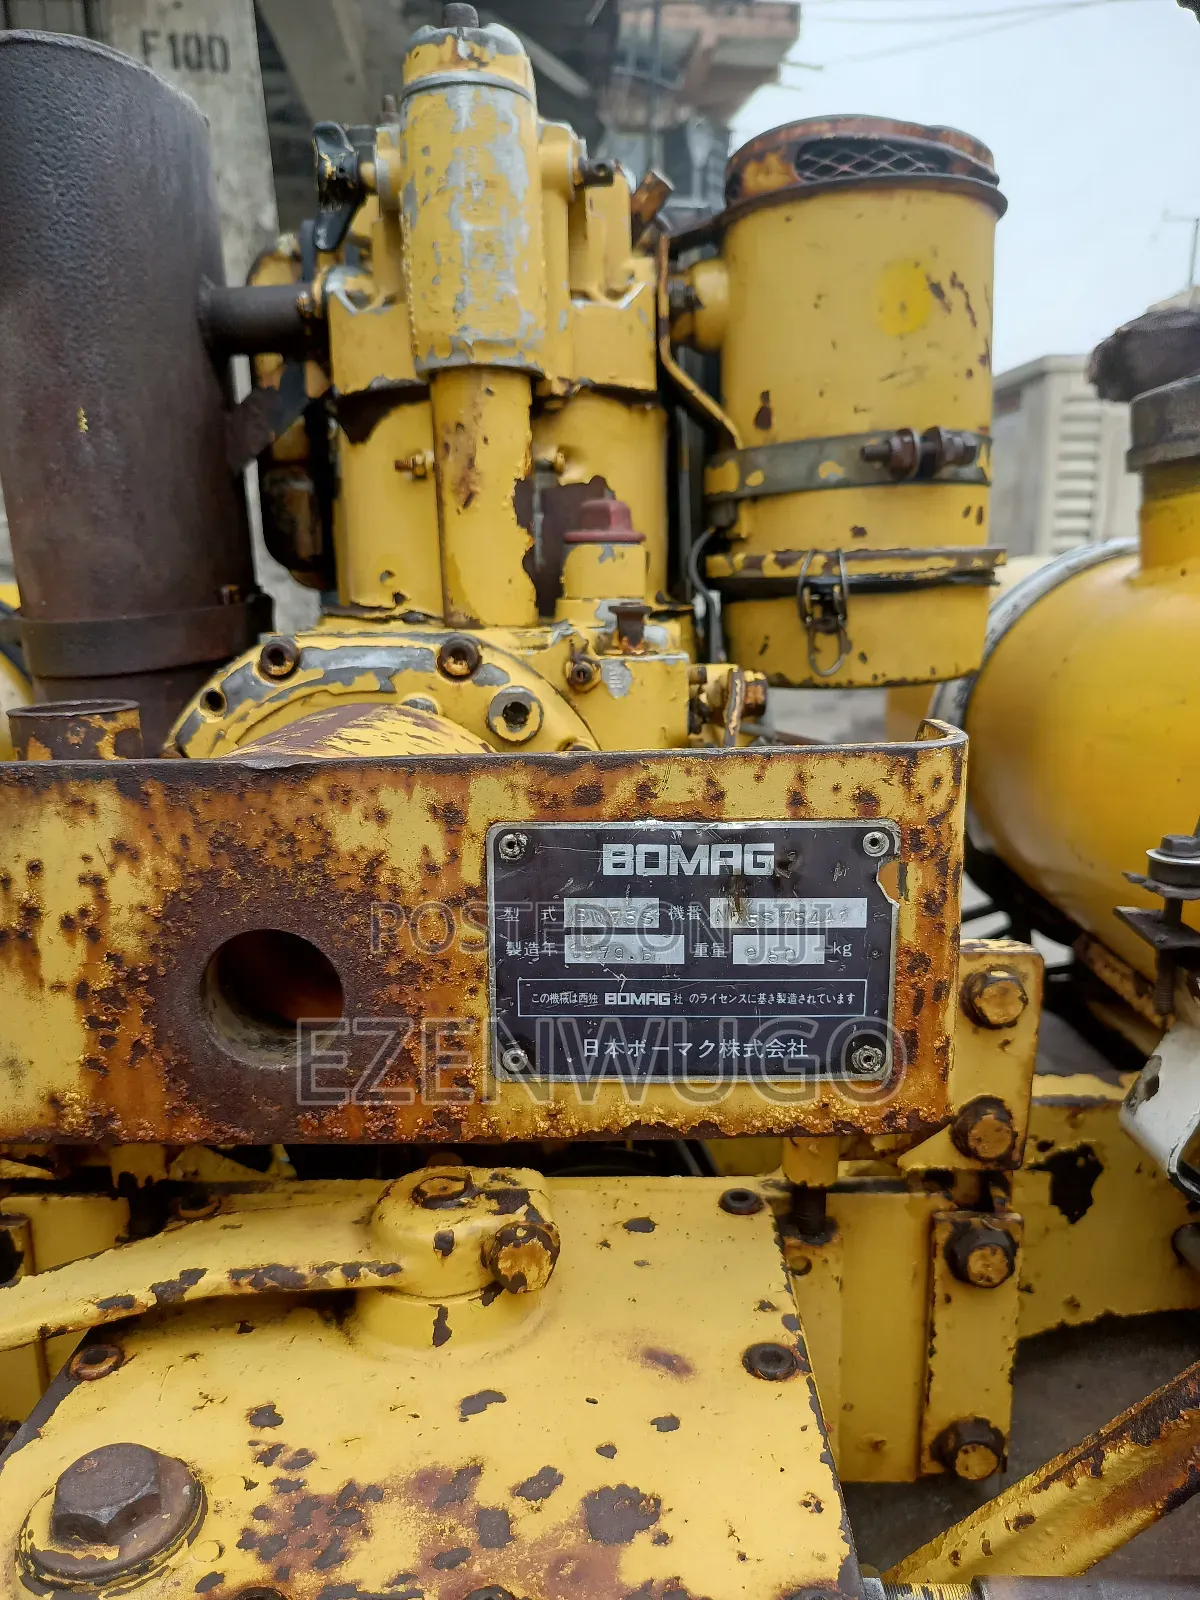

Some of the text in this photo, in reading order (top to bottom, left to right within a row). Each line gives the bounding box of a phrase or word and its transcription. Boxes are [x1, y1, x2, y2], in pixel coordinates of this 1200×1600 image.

[602, 843, 775, 876] BOMAG
[668, 905, 702, 921] 機番
[505, 941, 558, 957] 製造年
[693, 942, 727, 958] 重量
[832, 942, 852, 957] kg
[604, 993, 671, 1006] BOMAG
[673, 993, 684, 1005] 社
[689, 992, 856, 1006] のライセンスに基き製造されています
[583, 1038, 809, 1059] 日本ボーマク株式会社
